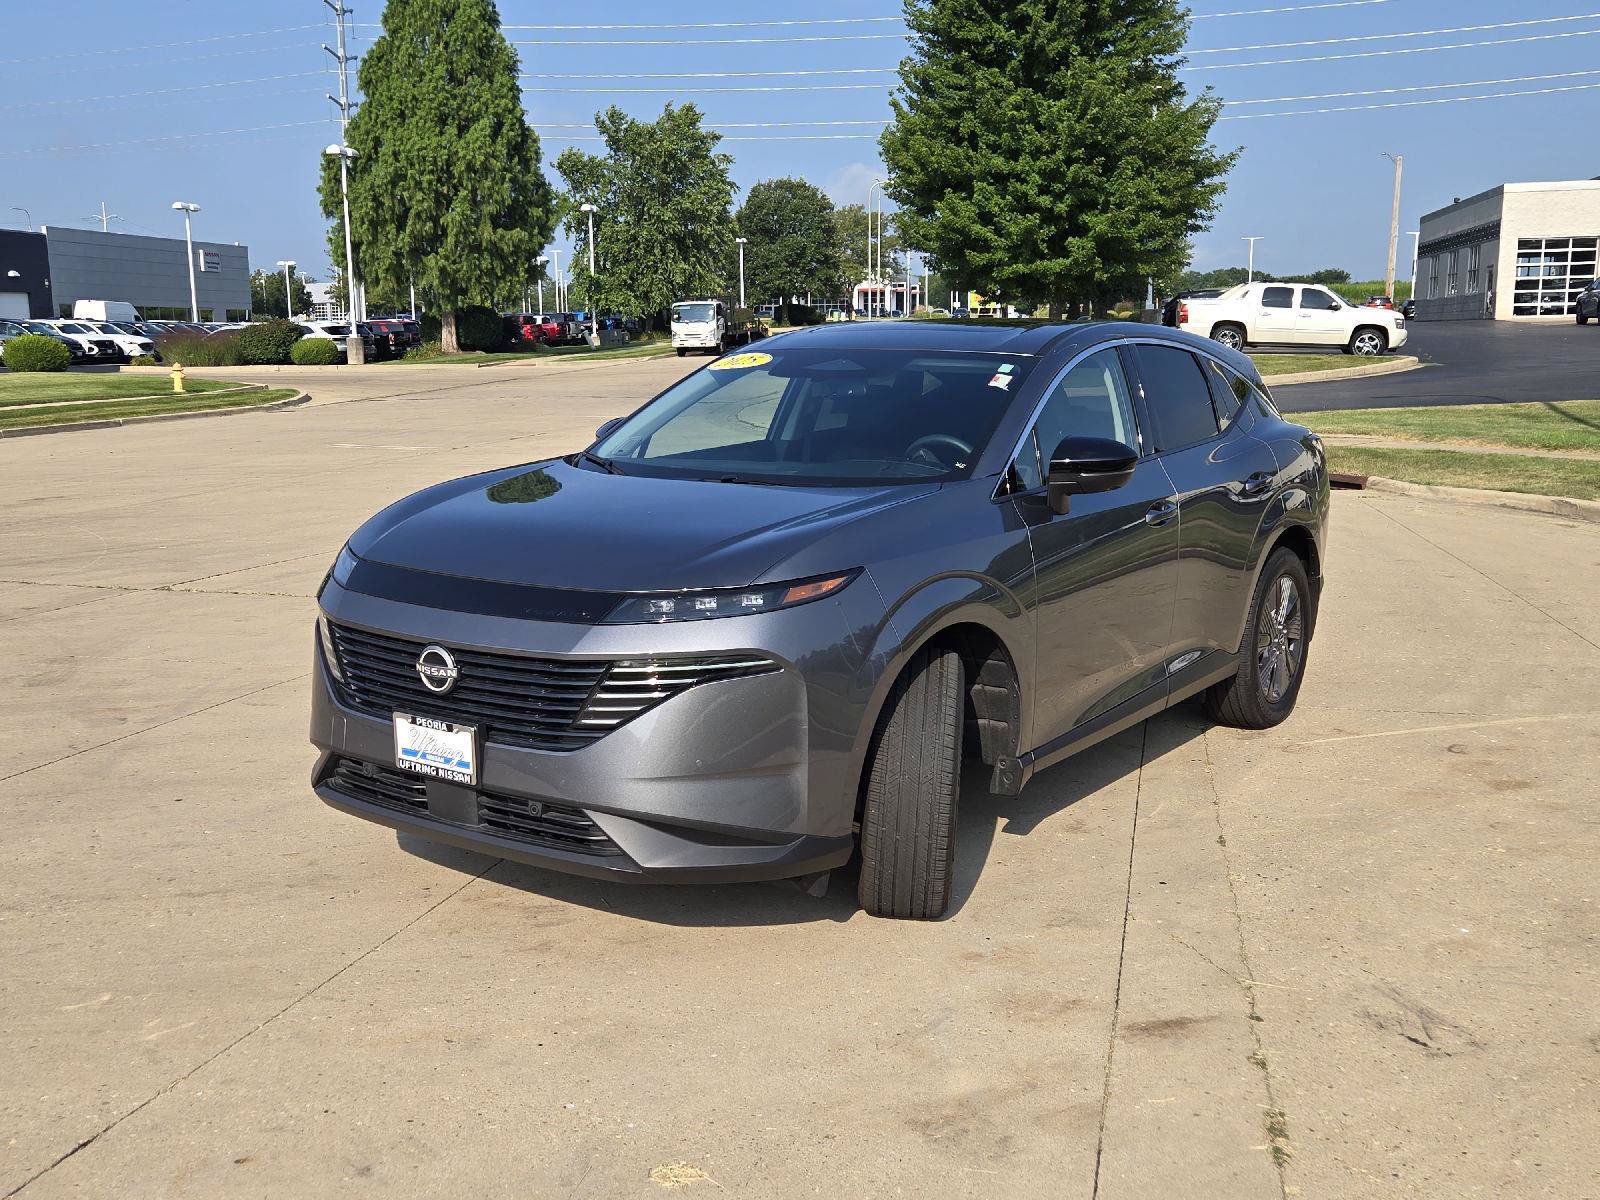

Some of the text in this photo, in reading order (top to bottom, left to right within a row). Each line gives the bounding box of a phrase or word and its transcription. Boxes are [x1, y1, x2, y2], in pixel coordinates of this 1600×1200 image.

[415, 663, 458, 678] NISSAN
[415, 717, 448, 732] PEORIA
[399, 759, 471, 784] UFTRING NISSAN
